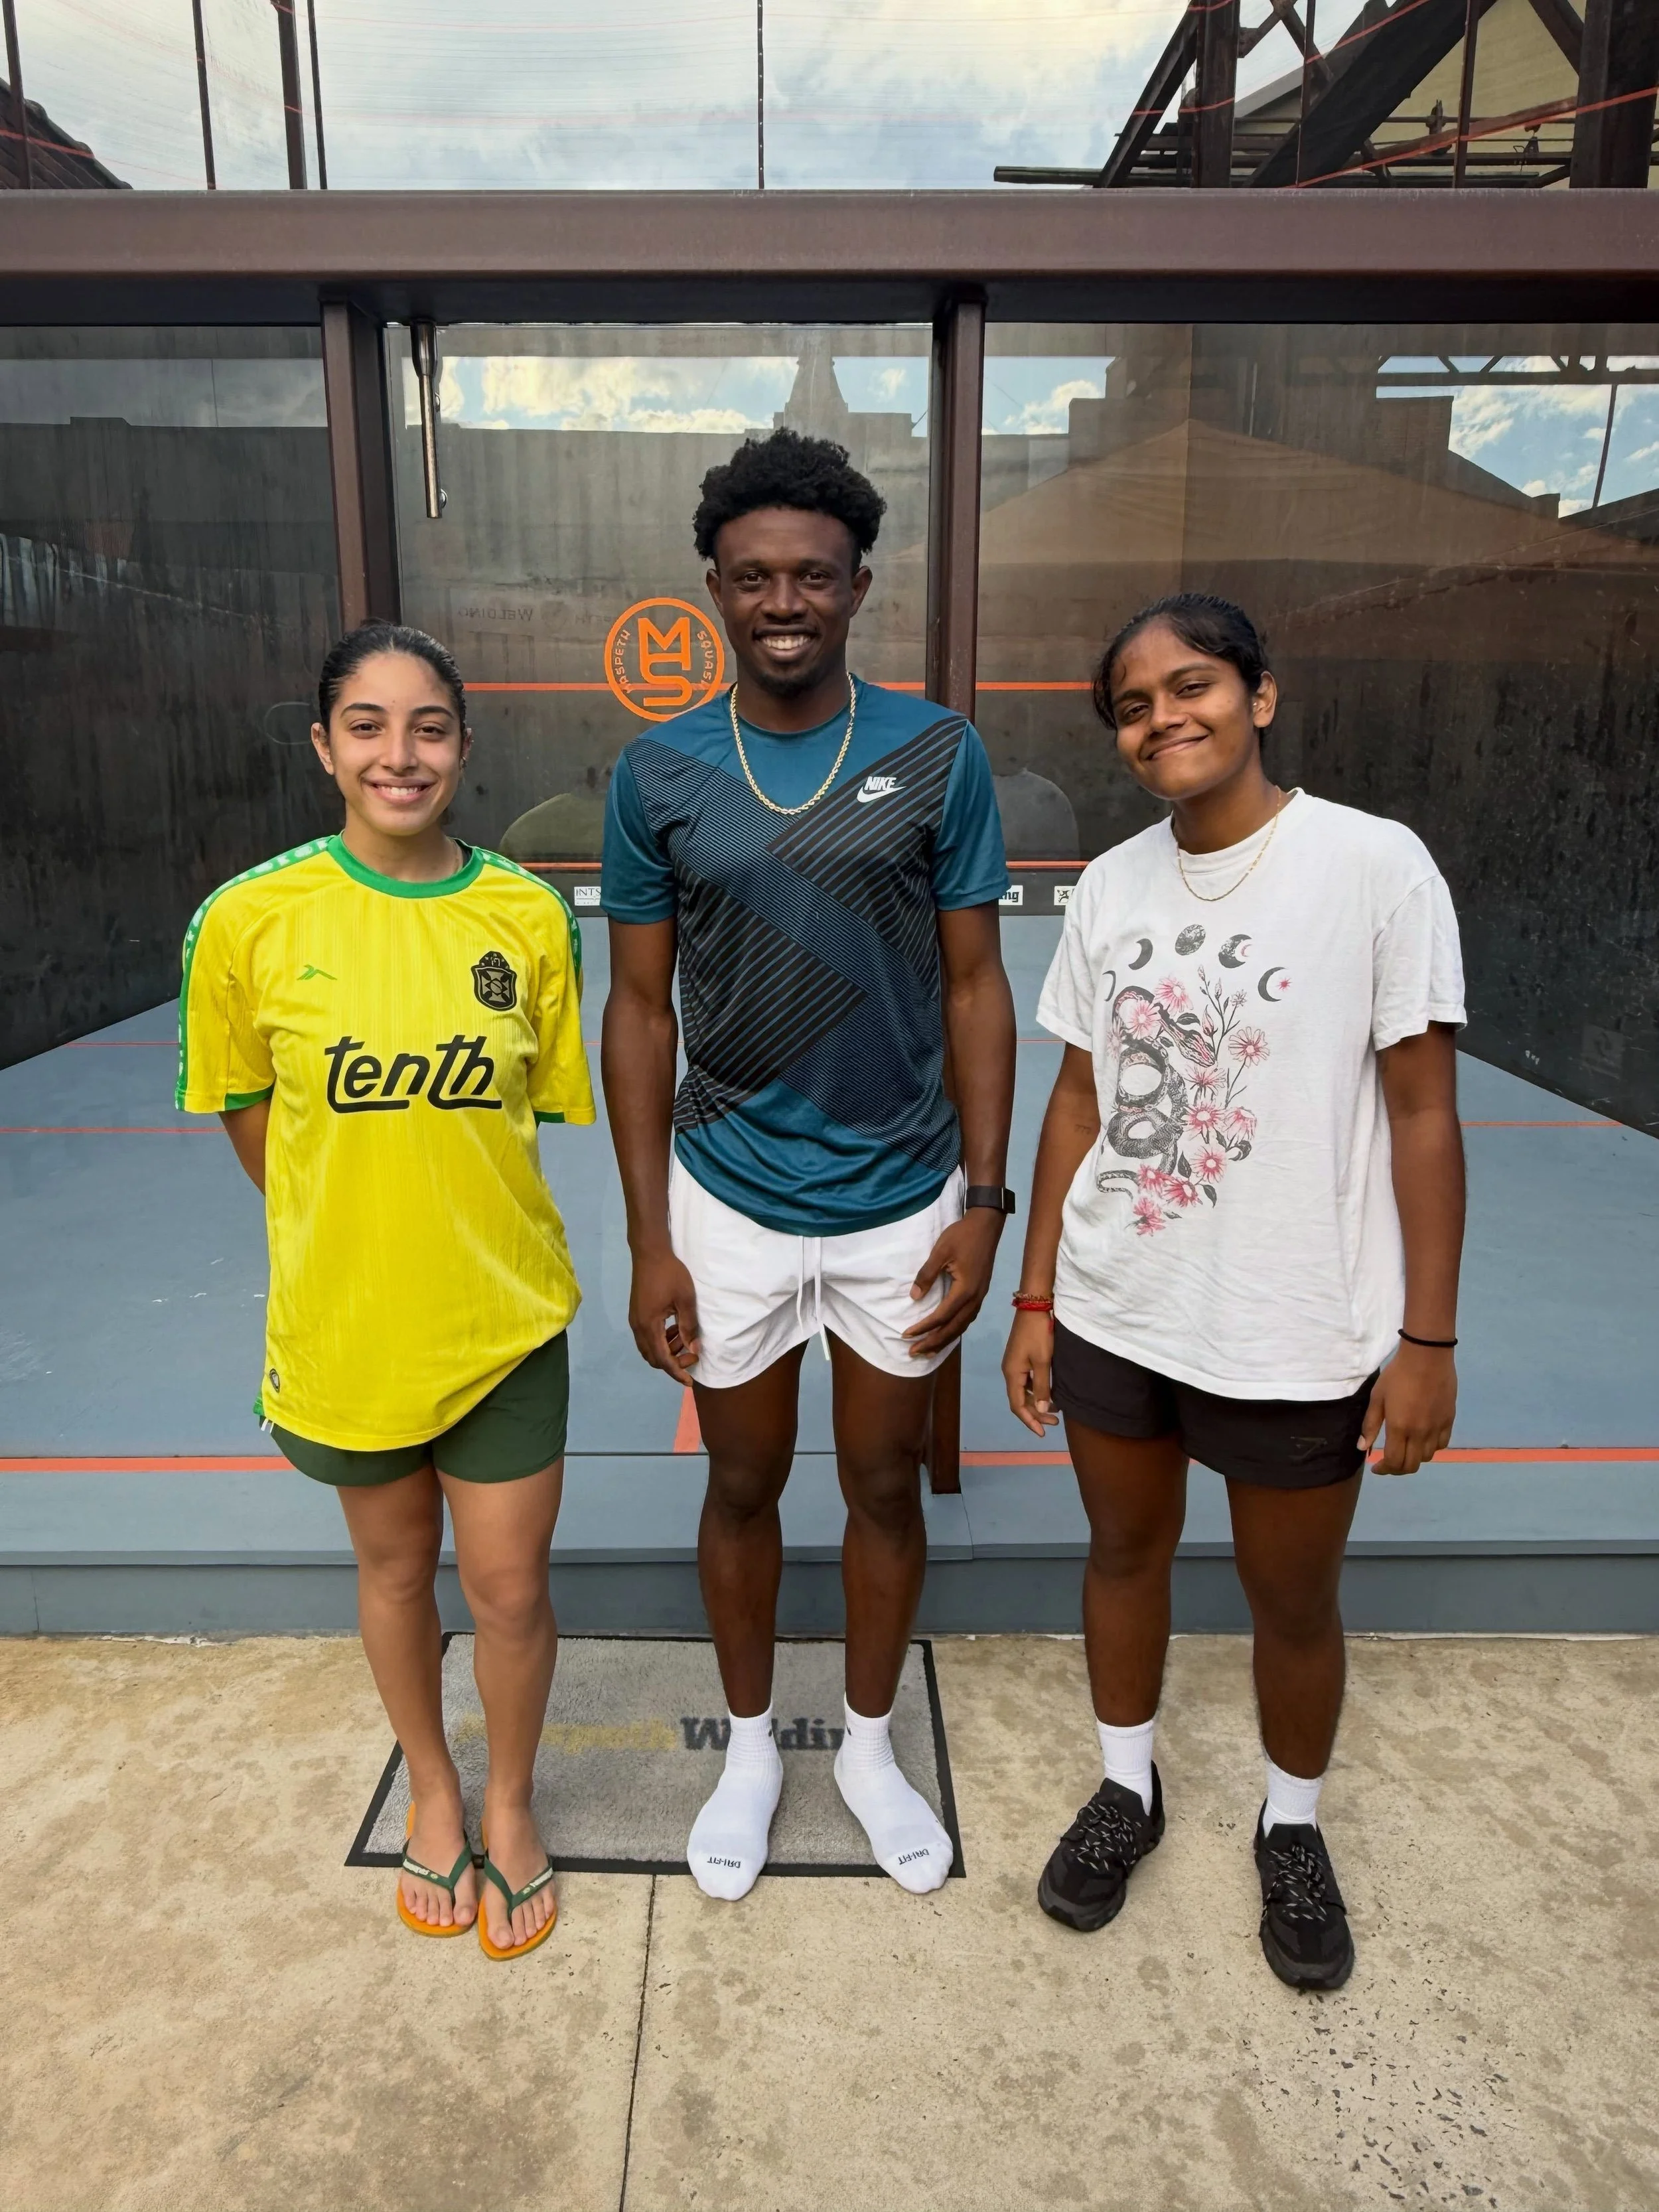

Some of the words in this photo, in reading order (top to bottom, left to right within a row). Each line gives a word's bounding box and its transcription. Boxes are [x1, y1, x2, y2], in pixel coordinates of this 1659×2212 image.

[864, 776, 897, 790] NIKE
[325, 1035, 502, 1114] tenth
[707, 1856, 741, 1868] DRI-FIT
[898, 1848, 930, 1865] DRI-FIT
